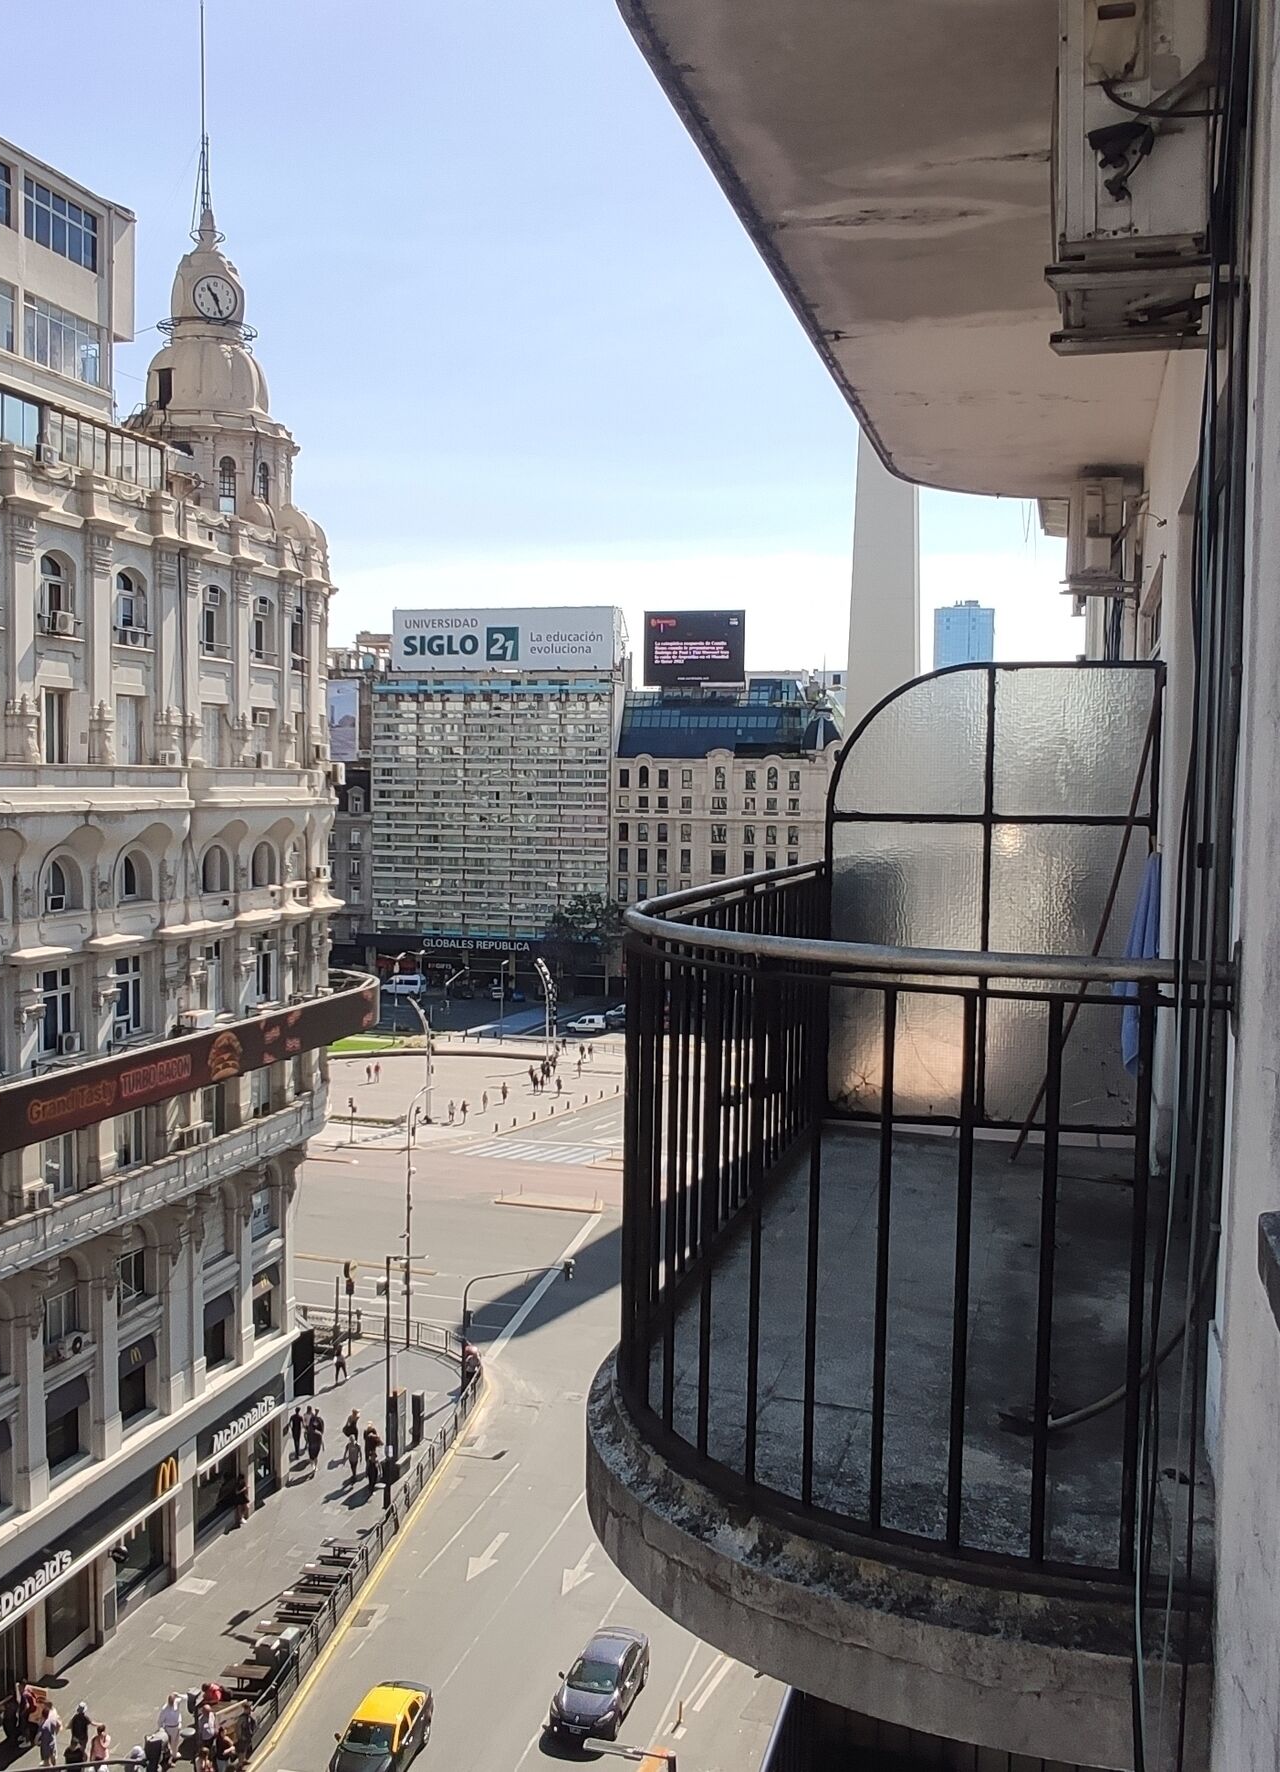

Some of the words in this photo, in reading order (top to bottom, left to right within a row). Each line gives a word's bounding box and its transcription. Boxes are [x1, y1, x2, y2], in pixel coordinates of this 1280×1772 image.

[404, 617, 478, 629] UNIVERSIDAD
[530, 631, 543, 642] La
[546, 631, 603, 642] educación
[403, 634, 479, 656] SIGLO
[530, 644, 591, 654] evoluciona
[422, 938, 474, 950] GLOBALES
[120, 1063, 157, 1097] TURBO
[157, 1053, 193, 1086] BACON
[212, 1395, 276, 1454] McDonald's
